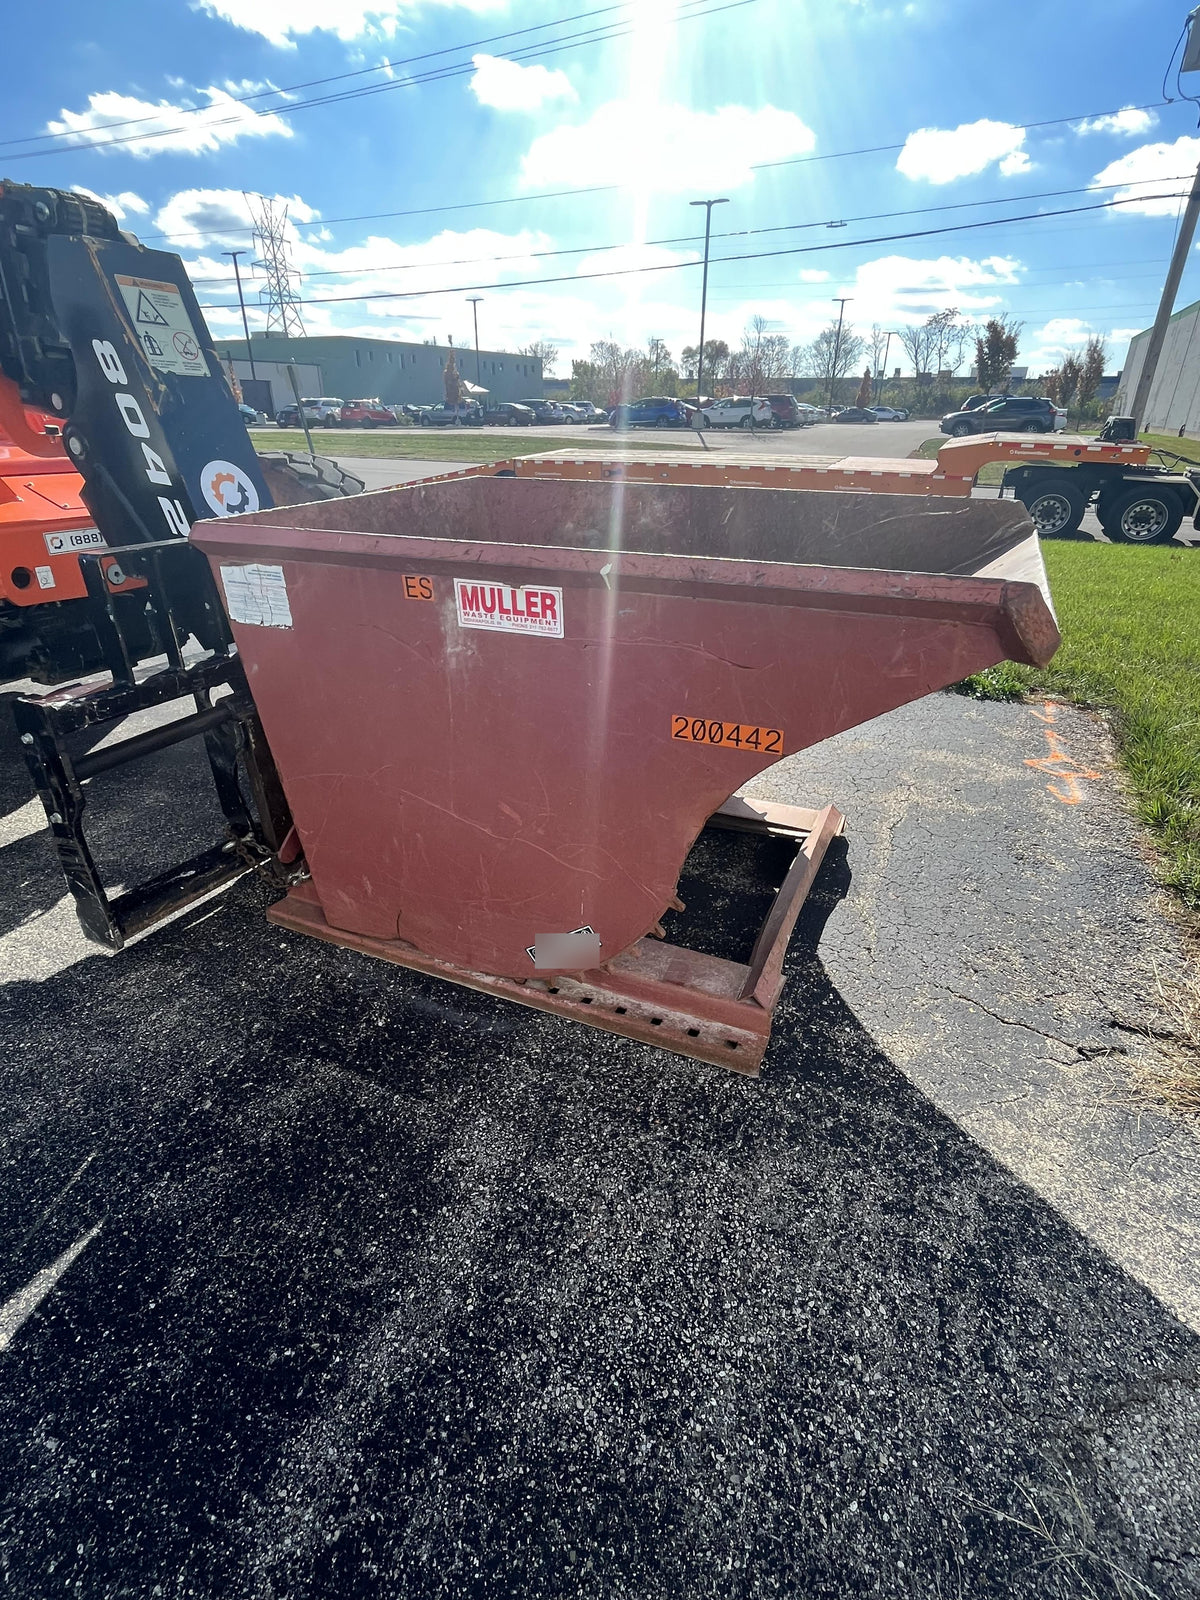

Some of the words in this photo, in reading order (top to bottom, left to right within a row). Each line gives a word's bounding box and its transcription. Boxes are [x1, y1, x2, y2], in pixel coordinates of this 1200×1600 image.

[92, 339, 191, 537] 8042
[405, 576, 432, 599] ES
[460, 585, 557, 619] MULLER
[463, 611, 495, 620] WASTE
[499, 615, 558, 627] EQUIPMENT
[674, 716, 781, 753] 200442
